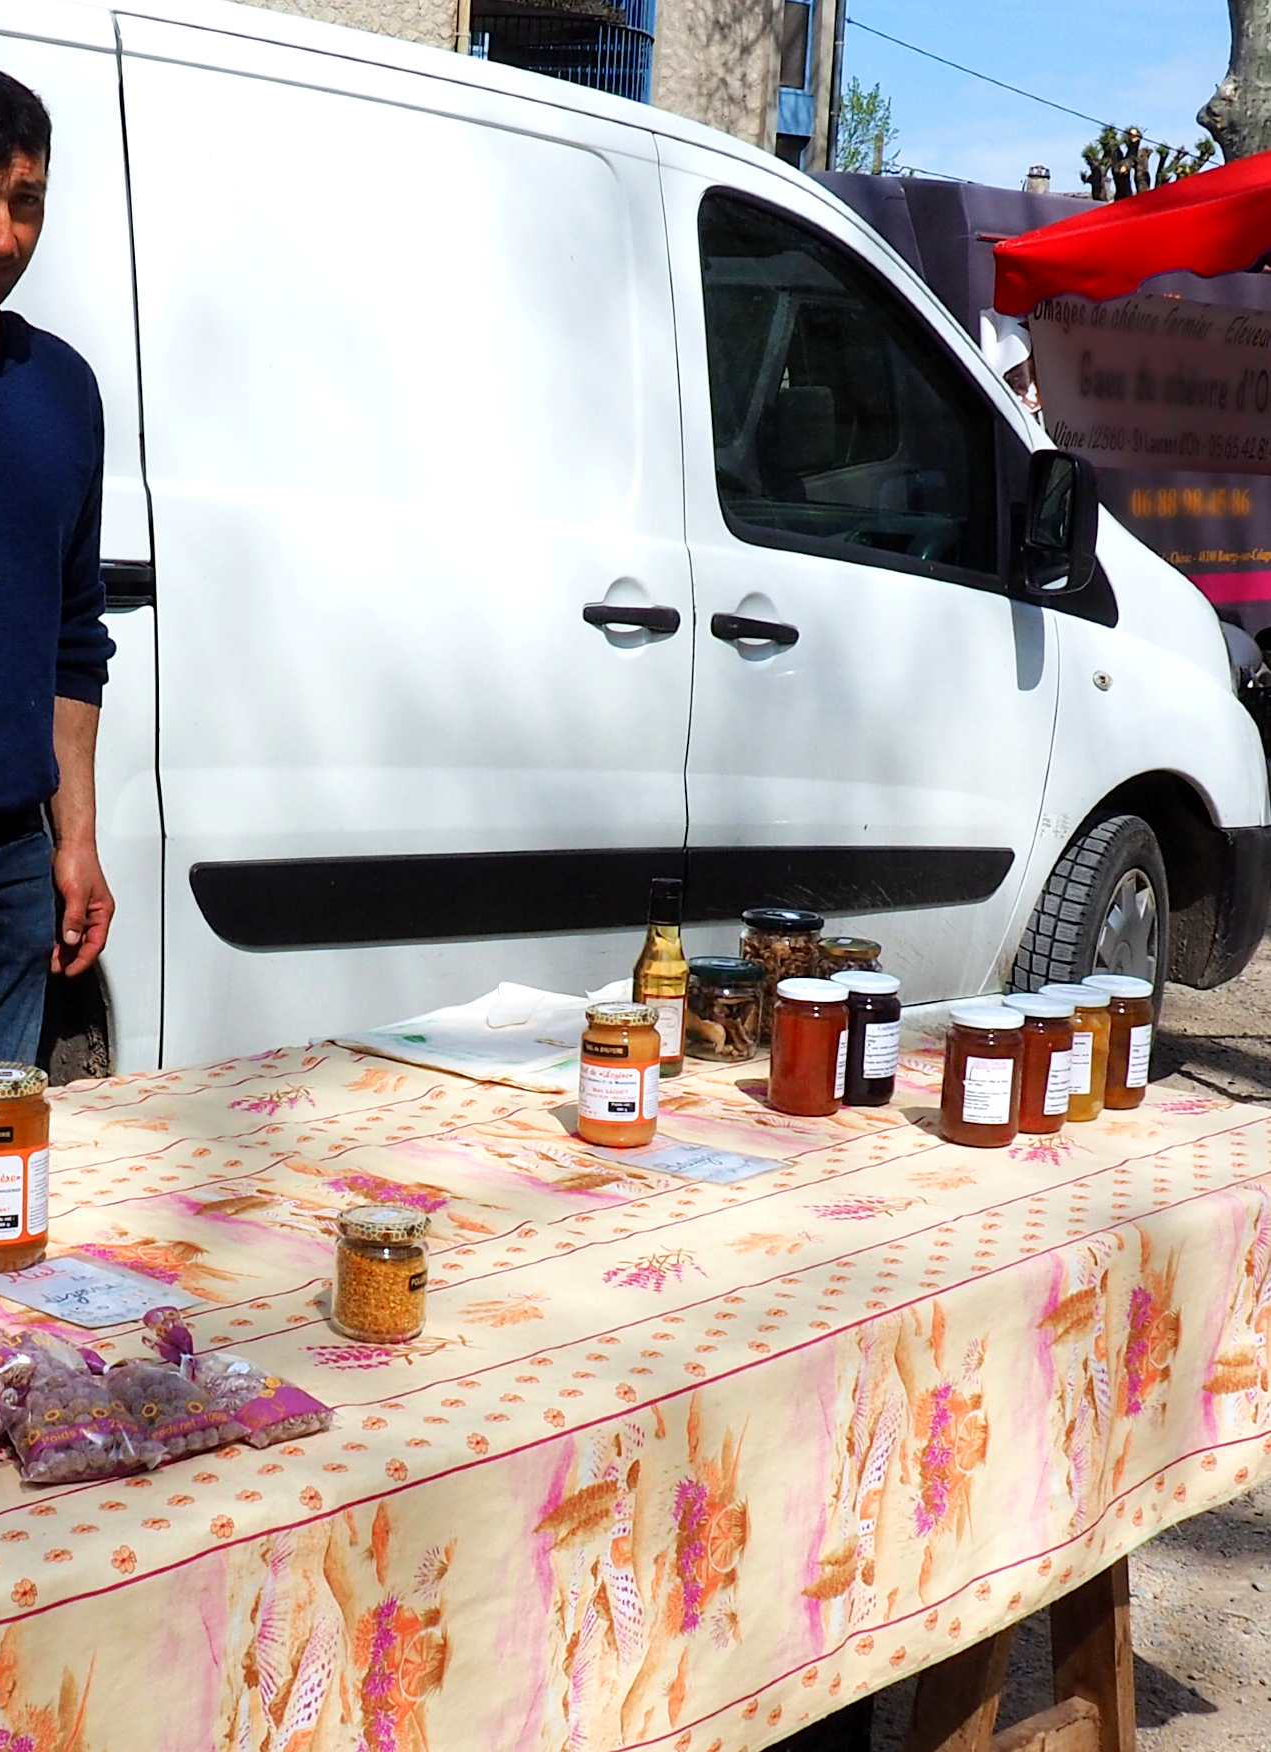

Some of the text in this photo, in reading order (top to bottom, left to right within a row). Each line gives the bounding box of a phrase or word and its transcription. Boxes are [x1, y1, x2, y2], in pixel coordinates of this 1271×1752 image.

[1090, 302, 1107, 328] de
[1162, 307, 1214, 340] fermier
[1053, 421, 1085, 450] Vigne
[1087, 424, 1125, 451] 12560
[3, 1264, 66, 1283] Miel
[41, 1429, 77, 1445] Poids
